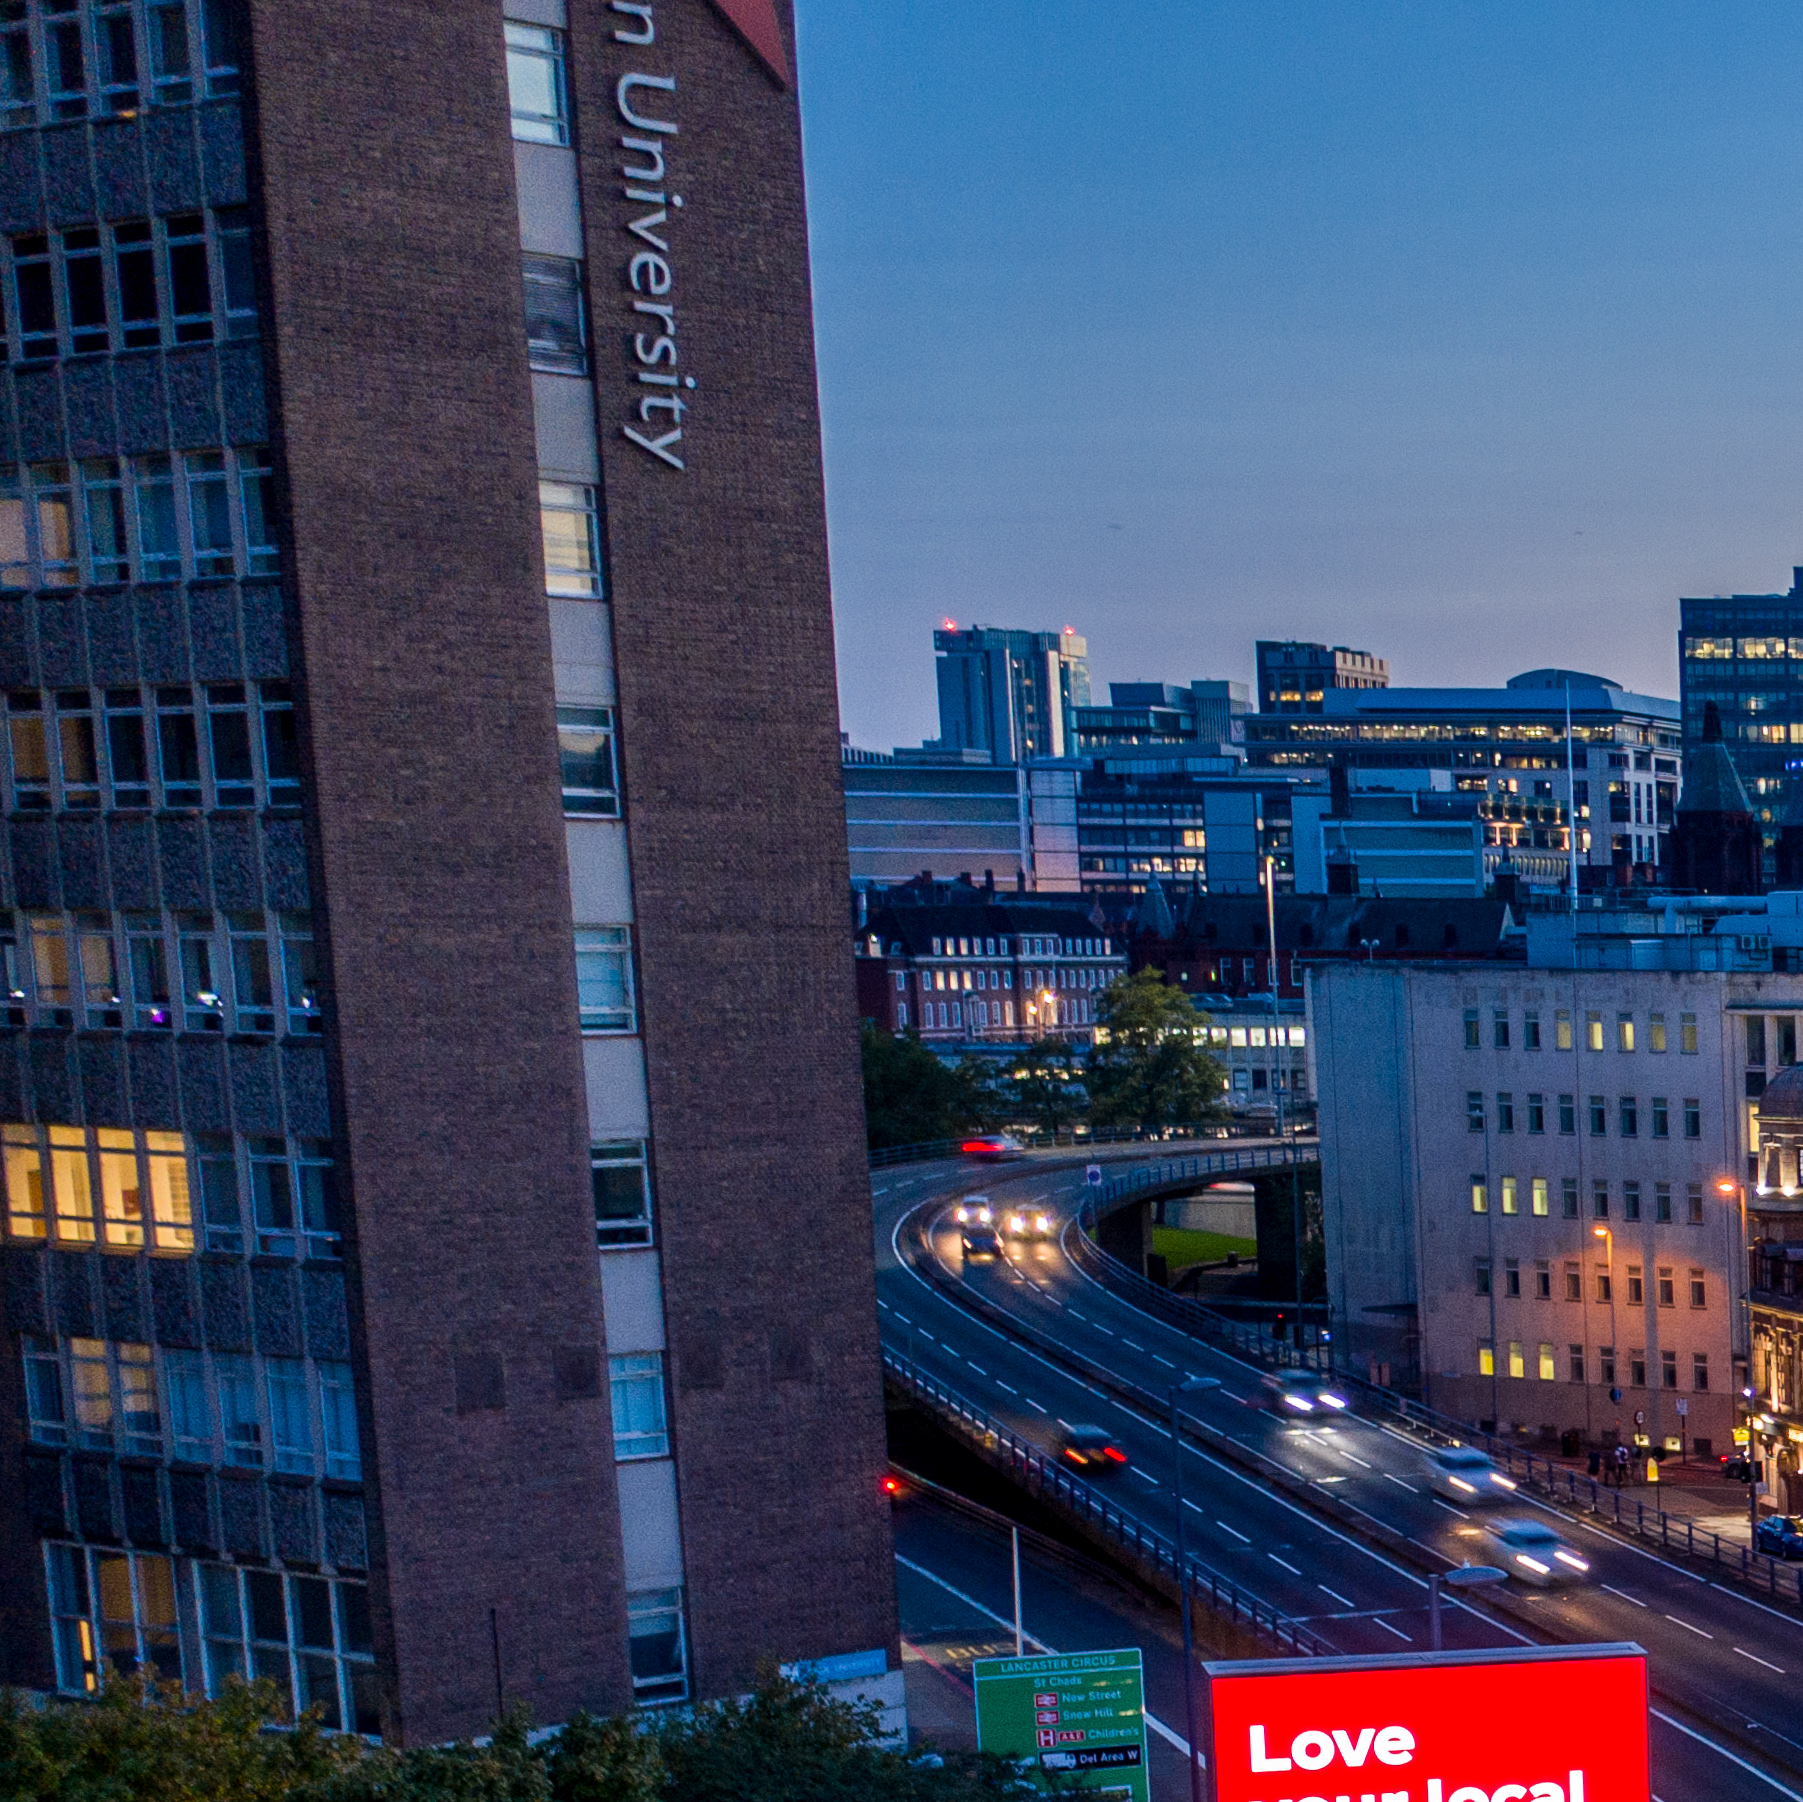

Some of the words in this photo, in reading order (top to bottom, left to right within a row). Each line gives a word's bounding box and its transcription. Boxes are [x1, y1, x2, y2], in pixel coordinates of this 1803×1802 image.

[617, 72, 697, 471] University
[1001, 1658, 1069, 1673] LANCASTER
[1071, 1655, 1116, 1669] CIRCUS
[1034, 1677, 1046, 1688] St
[1049, 1676, 1082, 1687] Chads
[1061, 1692, 1085, 1703] New
[1088, 1690, 1122, 1701] Street
[1063, 1710, 1091, 1721] Snow
[1094, 1707, 1113, 1718] Hill
[1040, 1730, 1054, 1746] H
[1088, 1726, 1139, 1739] Children's
[1079, 1752, 1098, 1764] Del
[1100, 1751, 1124, 1762] Area
[1127, 1750, 1138, 1760] W
[1249, 1725, 1416, 1773] Love
